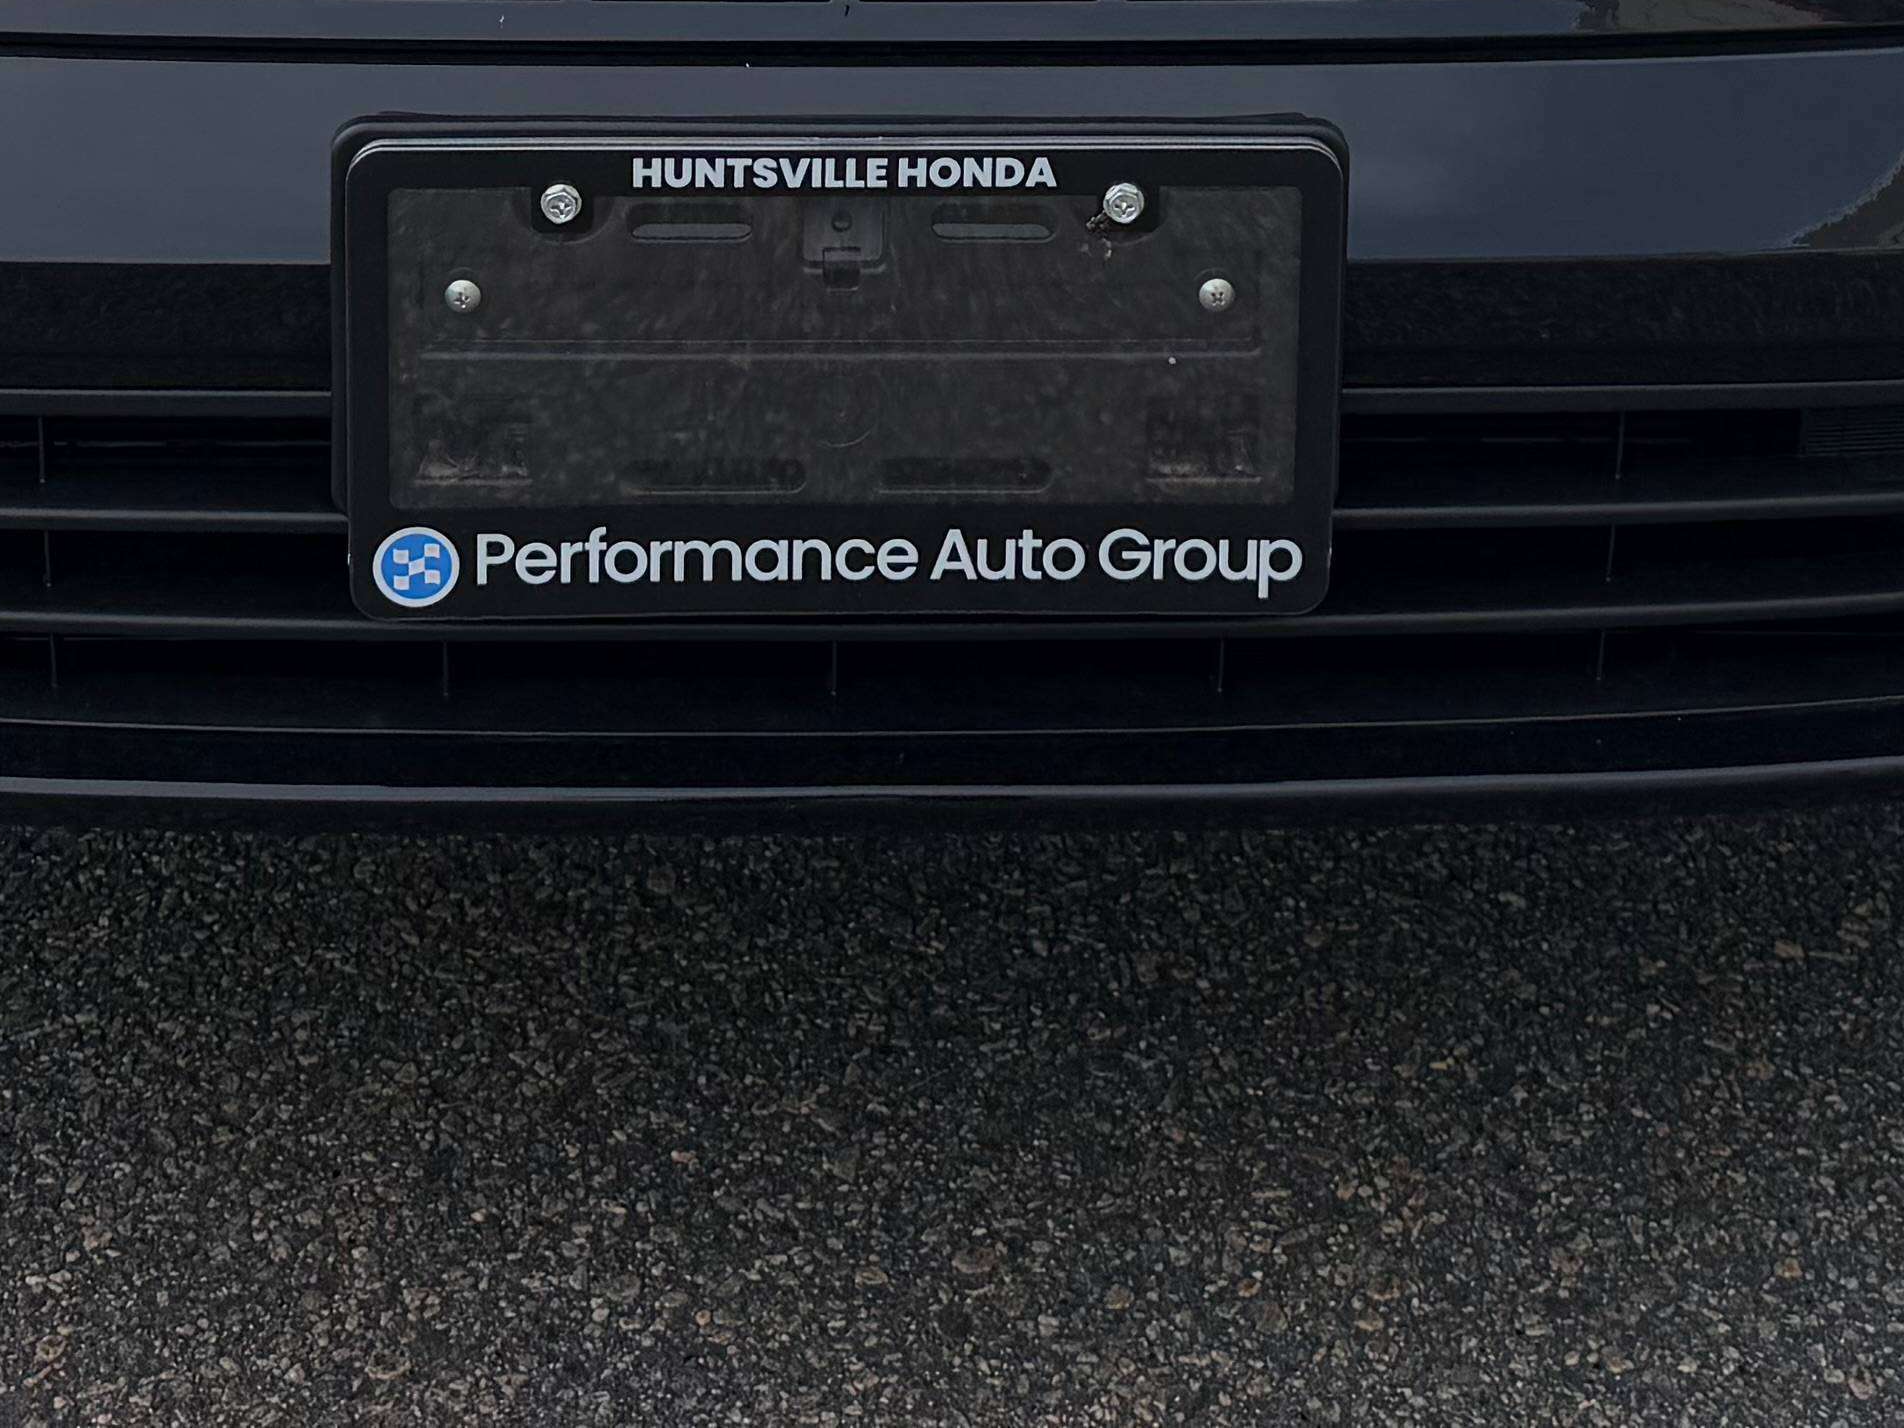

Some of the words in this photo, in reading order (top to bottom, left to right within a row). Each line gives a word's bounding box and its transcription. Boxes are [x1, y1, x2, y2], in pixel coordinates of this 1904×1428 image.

[632, 156, 888, 189] HUNTSVILLE
[897, 156, 1058, 189] HONDA
[475, 526, 920, 586] Performance
[929, 528, 1086, 581] Auto
[1098, 527, 1304, 600] Group
